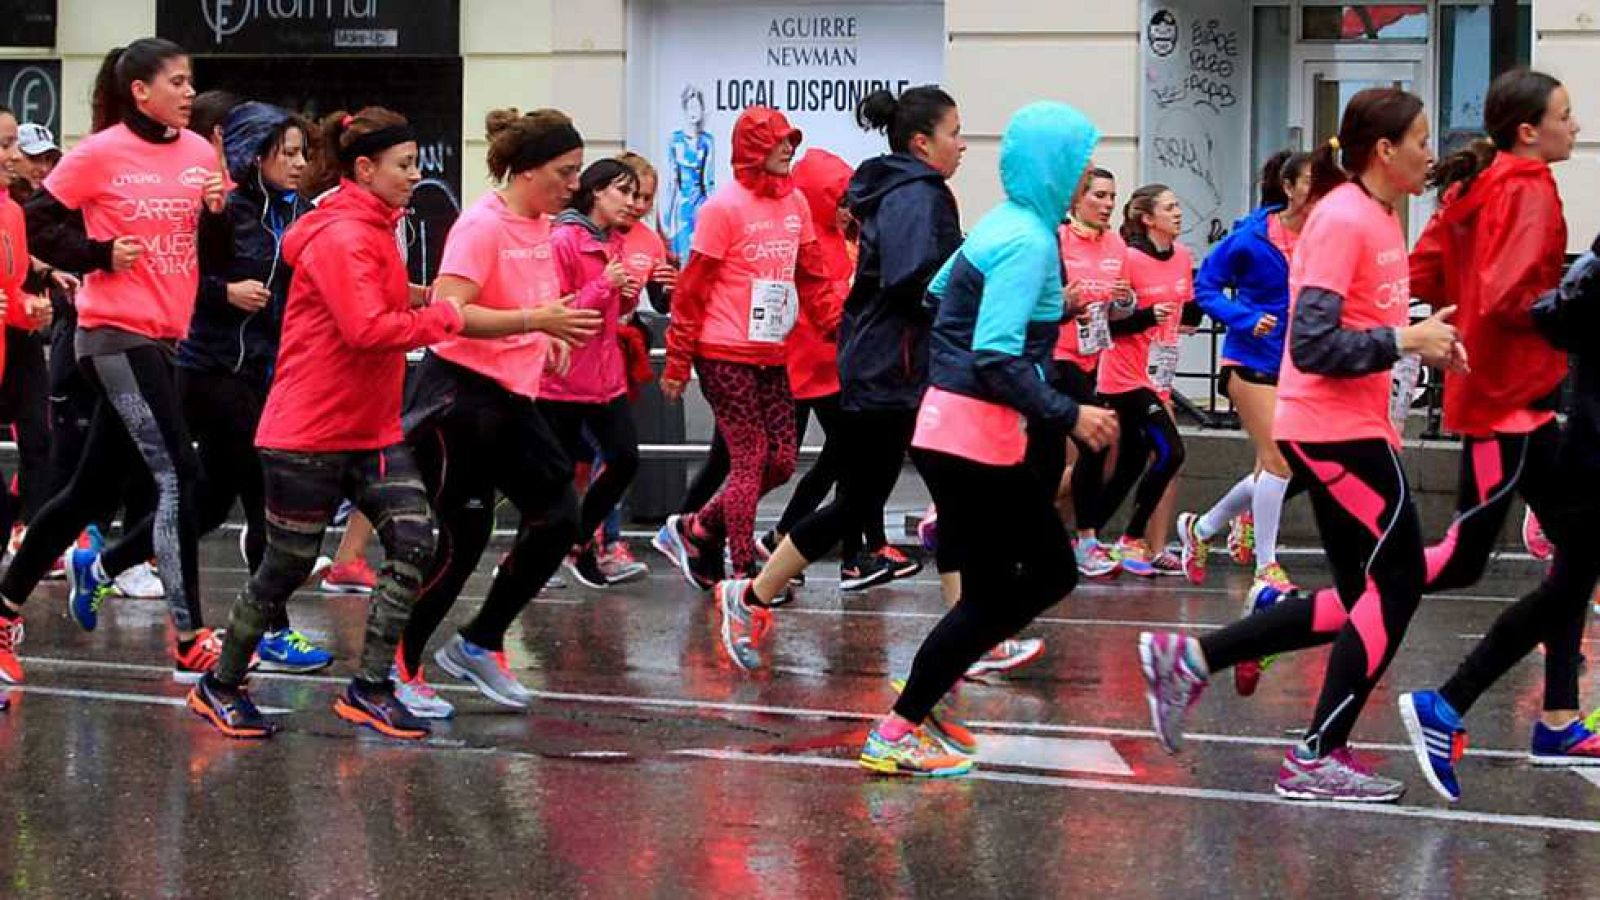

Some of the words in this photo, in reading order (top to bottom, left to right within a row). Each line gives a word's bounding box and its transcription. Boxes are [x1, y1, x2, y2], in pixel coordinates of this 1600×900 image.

[768, 17, 857, 38] AGUIRRE
[767, 48, 857, 67] NEWMAN
[716, 80, 780, 111] LOCAL
